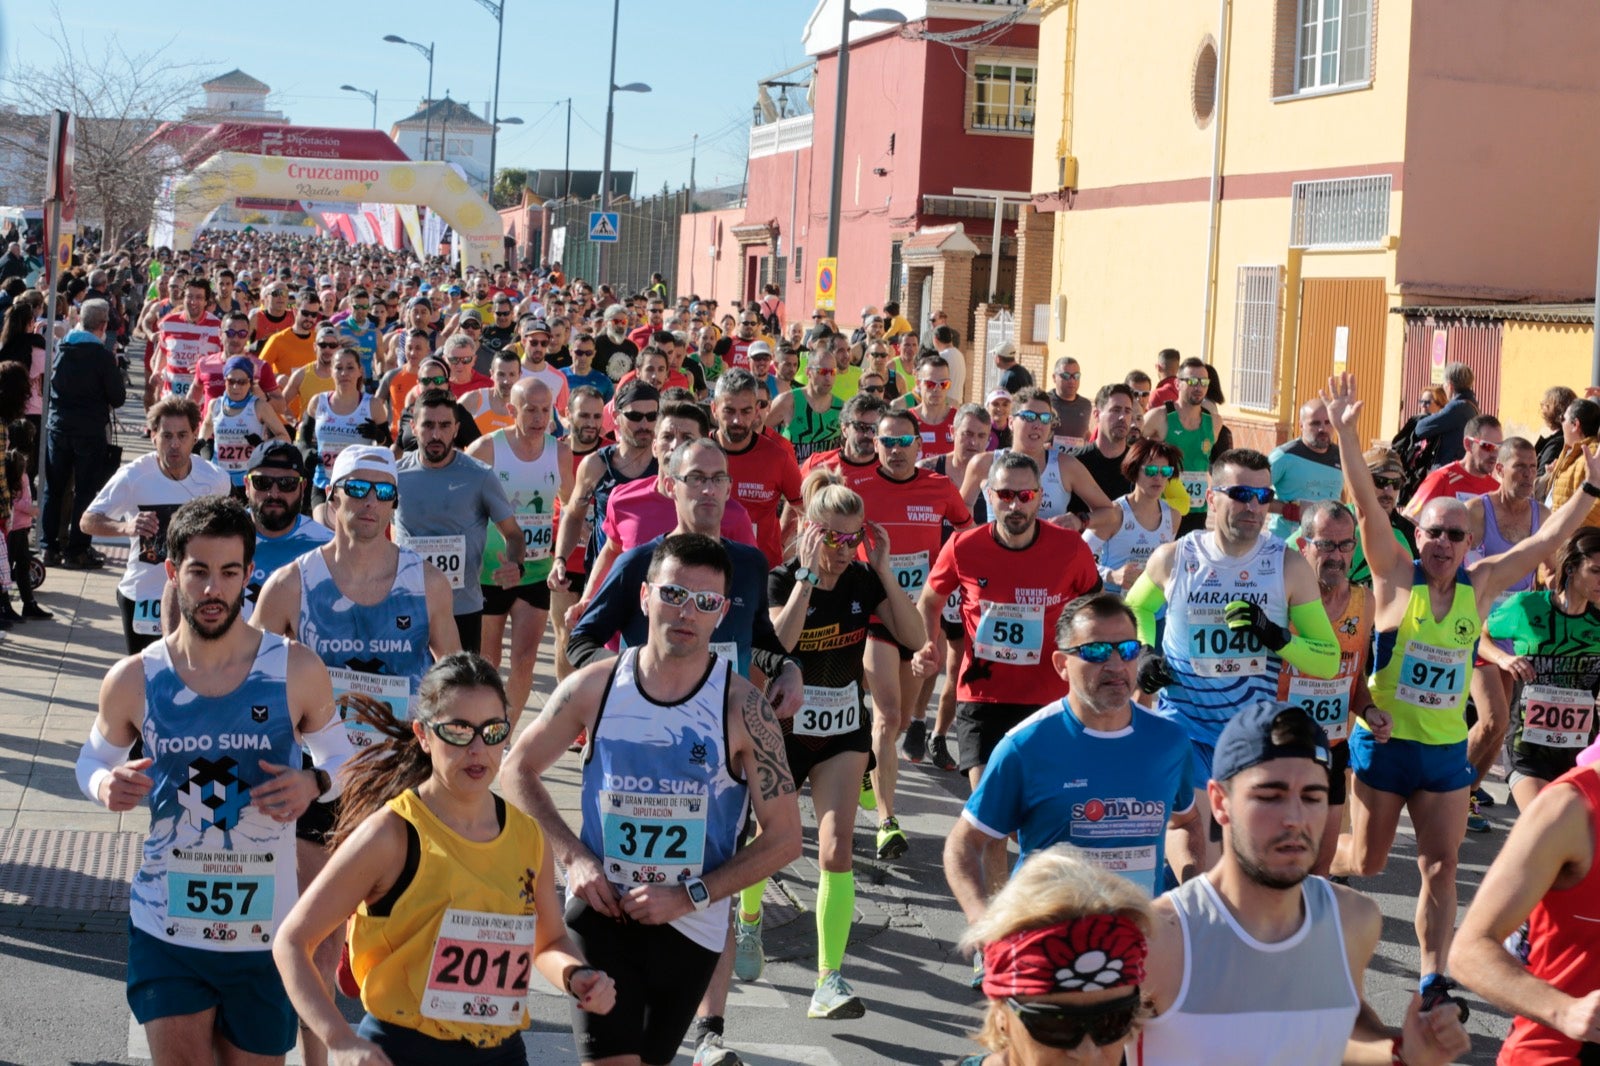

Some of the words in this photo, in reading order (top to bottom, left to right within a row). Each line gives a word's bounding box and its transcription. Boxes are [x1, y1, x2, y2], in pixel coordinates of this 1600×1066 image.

[287, 134, 340, 146] Diputación
[286, 147, 294, 155] de
[298, 148, 340, 158] Granada
[288, 163, 379, 182] Cruzcampo
[296, 183, 340, 196] Radler
[218, 446, 252, 460] 2276
[1184, 483, 1202, 496] 43
[1015, 588, 1048, 596] RUNNING
[1016, 593, 1062, 607] VAMPIROS
[992, 620, 1024, 644] 58
[320, 639, 364, 653] TODO
[369, 640, 412, 653] SUMA
[801, 642, 817, 650] FOR
[1411, 662, 1456, 690] 971
[802, 706, 856, 731] 3010
[1529, 704, 1590, 730] 2067
[158, 734, 212, 754] TODO
[218, 734, 272, 750] SUMA
[658, 778, 708, 794] SUMA
[625, 795, 642, 805] GRAN
[644, 797, 668, 807] PREMIO
[670, 798, 678, 807] DE
[633, 807, 673, 818] DIPUTACIÓN
[619, 822, 688, 859] 372
[194, 853, 212, 862] GRAN
[214, 853, 238, 862] PREMIO
[240, 854, 248, 862] DE
[250, 854, 269, 863] FOND
[202, 864, 244, 874] DIPUTACIÓN
[186, 880, 259, 916] 557
[435, 946, 531, 990] 2012
